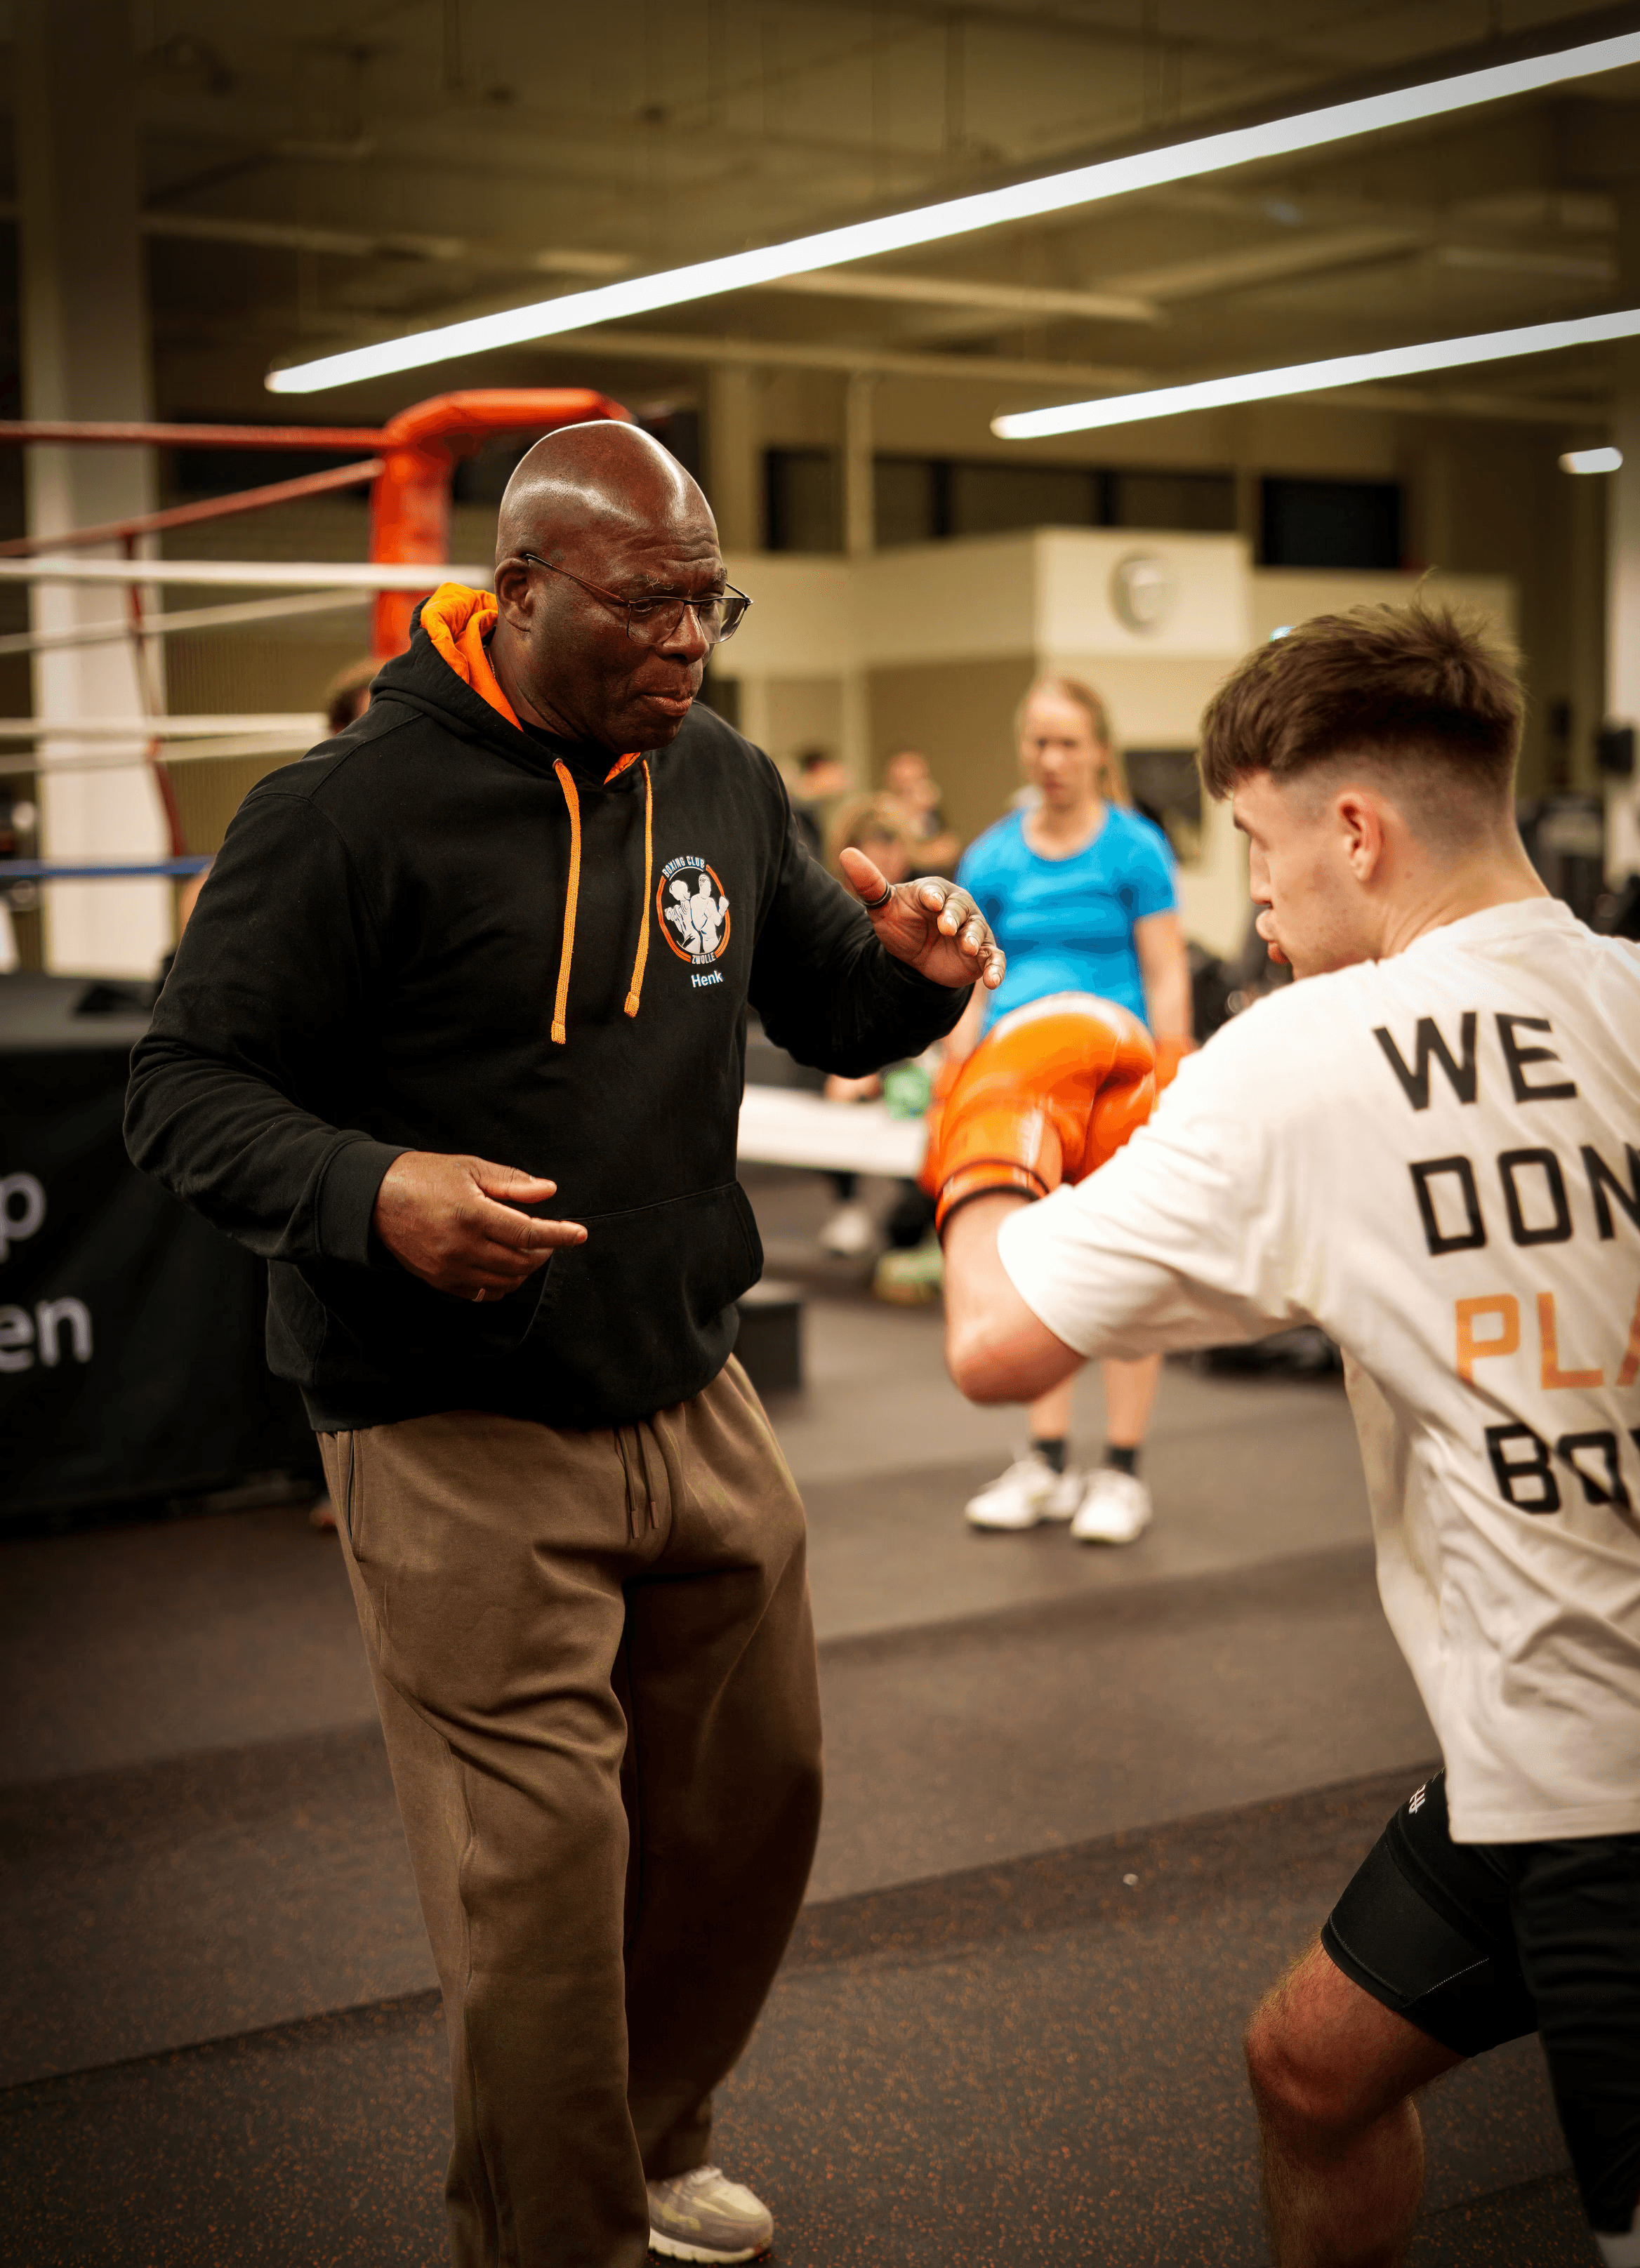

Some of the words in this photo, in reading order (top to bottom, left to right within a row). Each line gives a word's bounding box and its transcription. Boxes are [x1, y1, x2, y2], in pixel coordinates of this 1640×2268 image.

[662, 856, 685, 878] BOXING
[686, 856, 705, 869] CLUB
[692, 952, 716, 964] ZWOLLE
[691, 970, 723, 988] Henk
[1373, 1012, 1578, 1111] WE
[1485, 1424, 1640, 1514] BO
